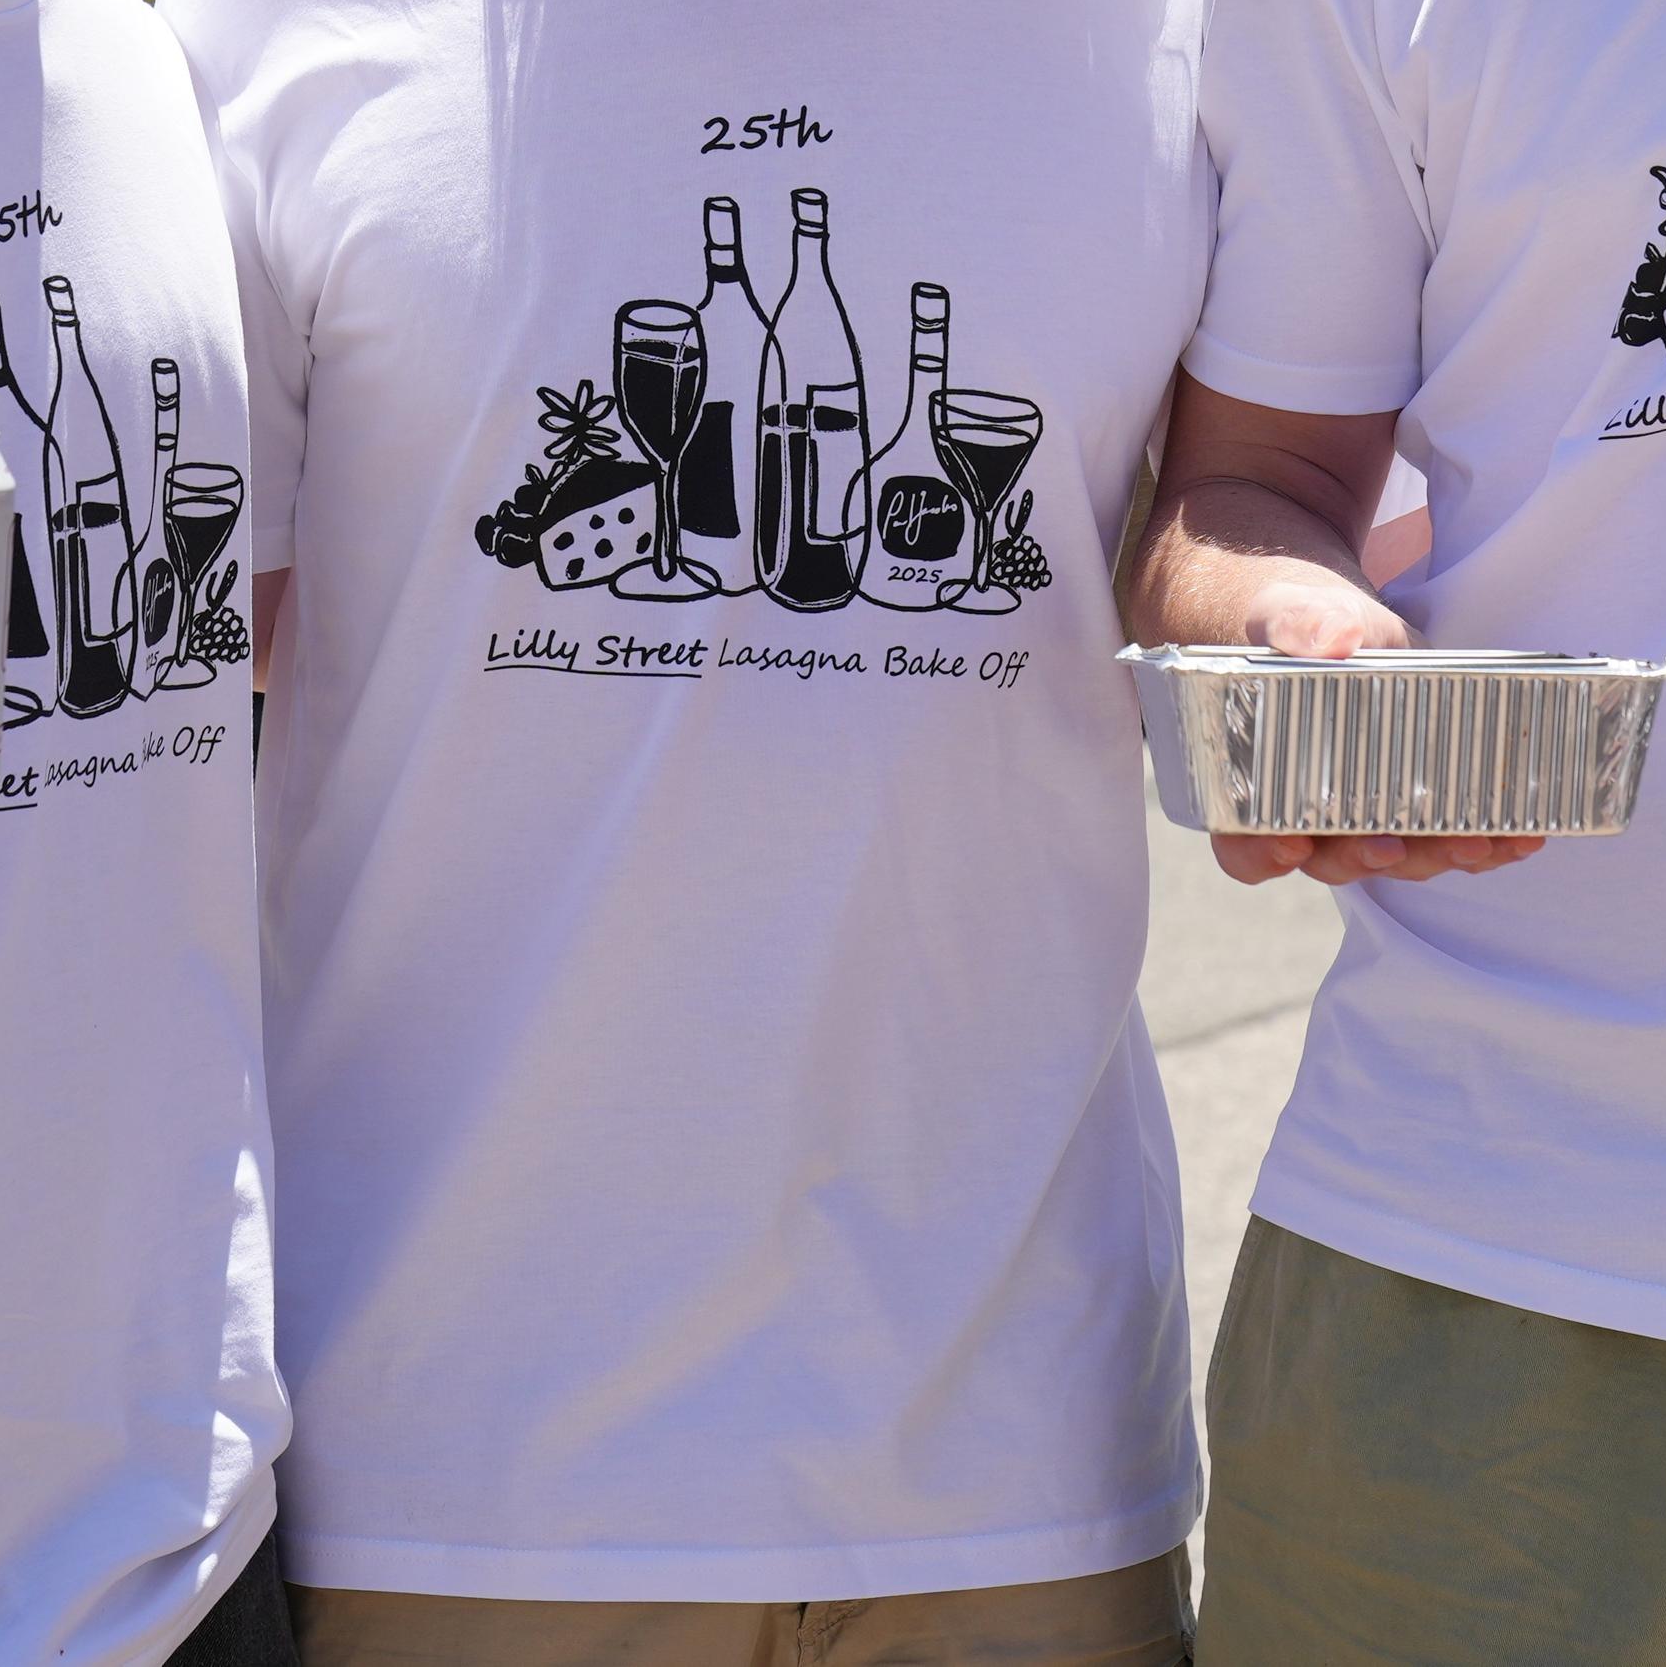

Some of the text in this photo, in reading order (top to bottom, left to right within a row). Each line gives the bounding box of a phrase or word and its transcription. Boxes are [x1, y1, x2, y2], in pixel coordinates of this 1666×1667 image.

[700, 105, 834, 155] 25th
[888, 565, 943, 585] 2025
[487, 629, 1030, 689] Lilly Street Lasagna Bake Off
[172, 724, 226, 764] Off
